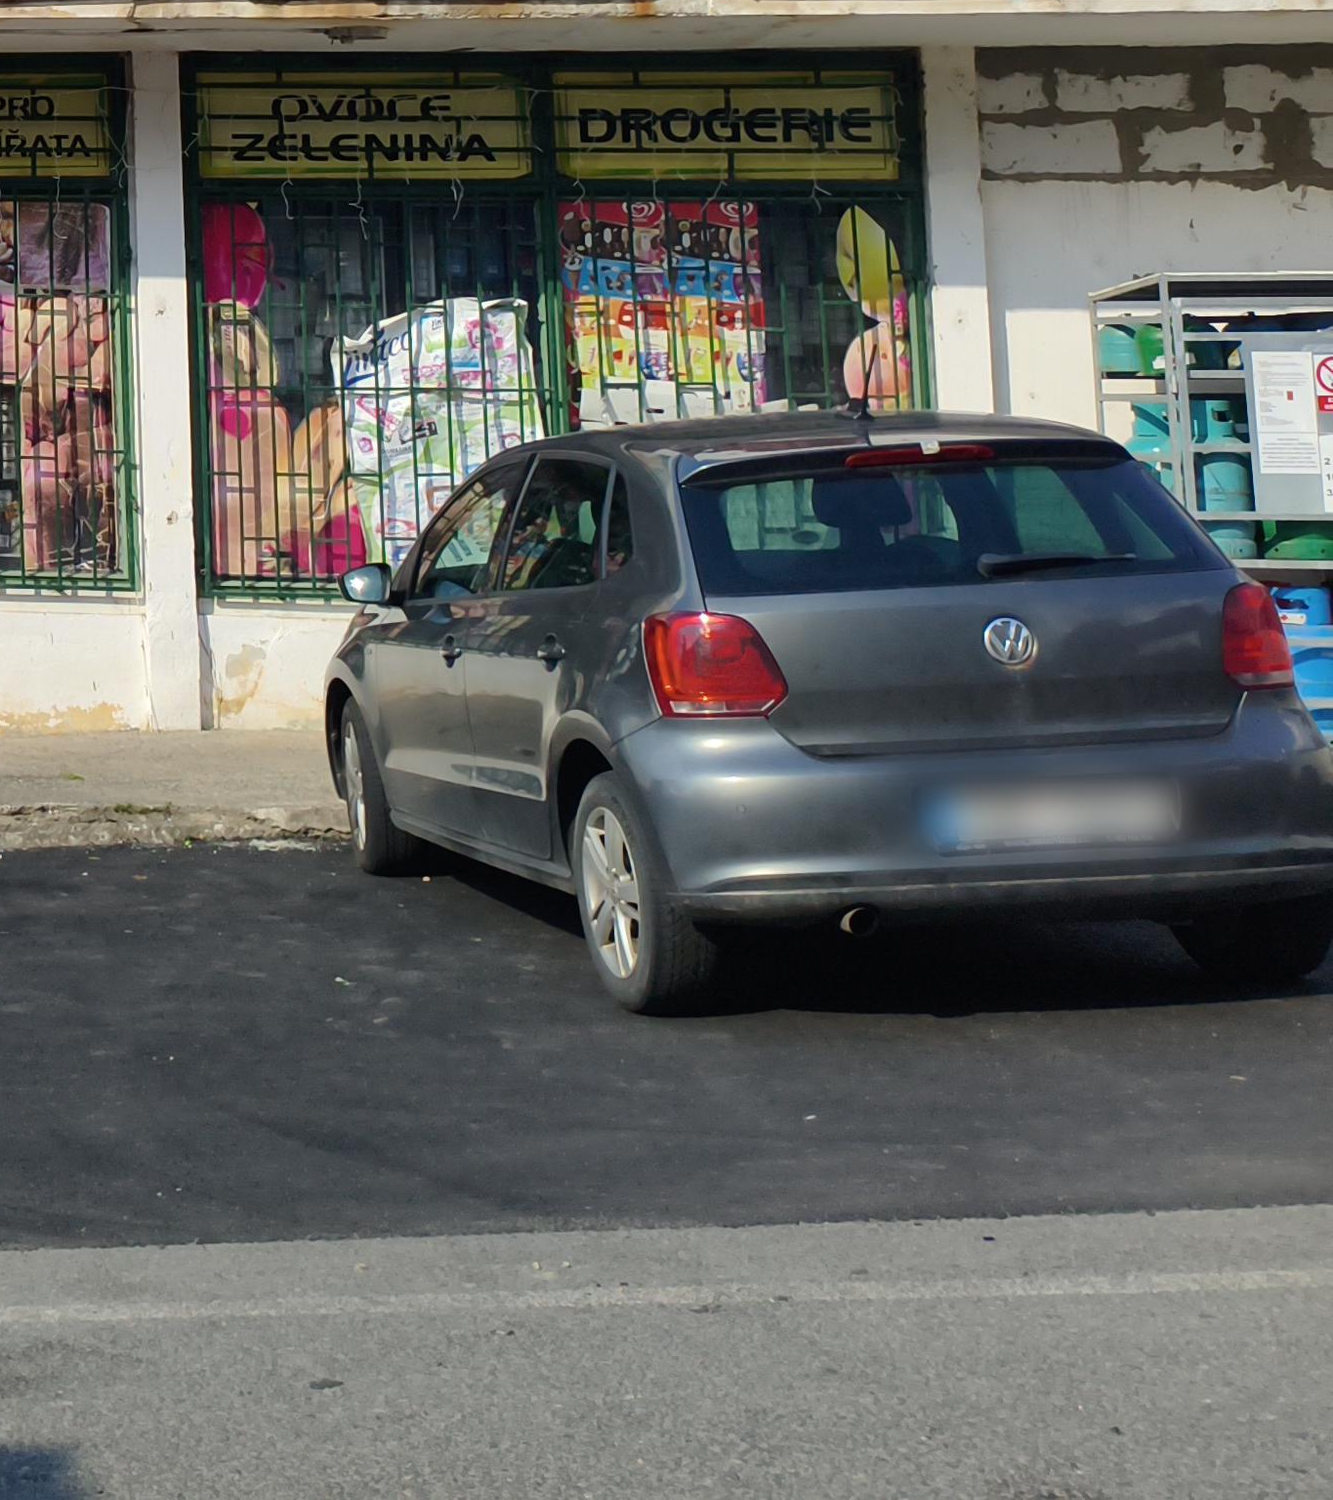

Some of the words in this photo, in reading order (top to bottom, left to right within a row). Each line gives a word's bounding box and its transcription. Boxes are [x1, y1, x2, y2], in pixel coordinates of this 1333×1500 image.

[271, 94, 451, 122] OVOCE
[578, 107, 872, 144] DROGERIE
[231, 133, 497, 162] ZELENINA
